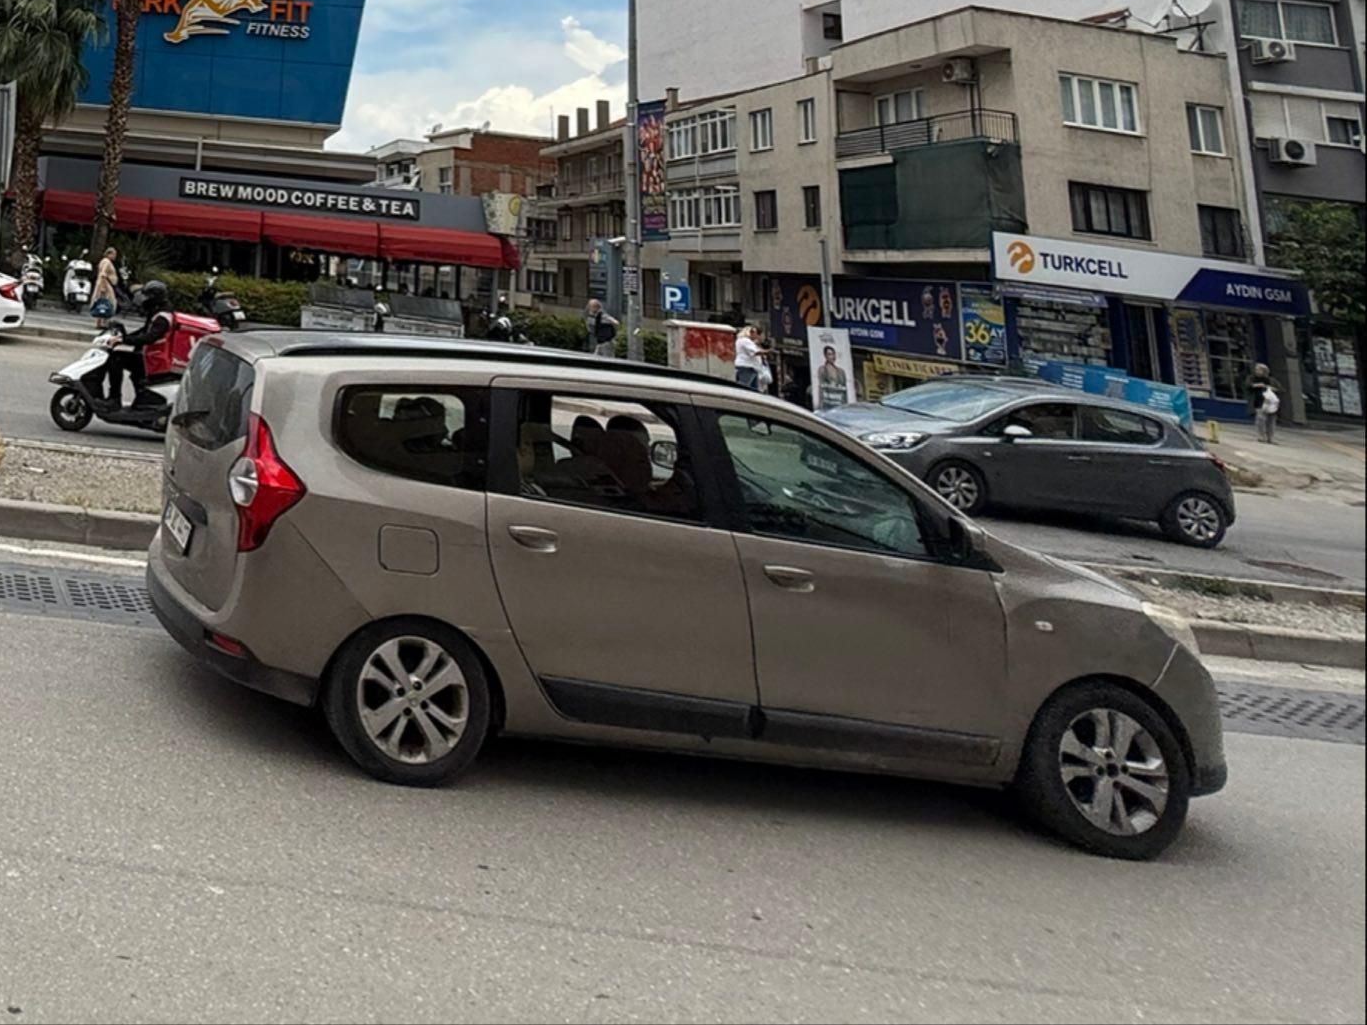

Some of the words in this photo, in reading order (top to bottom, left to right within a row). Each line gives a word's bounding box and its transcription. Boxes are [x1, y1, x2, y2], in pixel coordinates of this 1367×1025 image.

[245, 22, 311, 39] FITNESS
[184, 180, 234, 198] BREW
[237, 184, 288, 204] MOOD
[290, 190, 359, 211] COFFEE
[362, 197, 376, 212] &
[379, 199, 415, 216] TEA
[1038, 251, 1129, 280] TURKCELL
[665, 286, 682, 310] P
[1226, 282, 1262, 300] AYDIN
[1264, 286, 1293, 303] GSM
[832, 296, 916, 327] URKCELL
